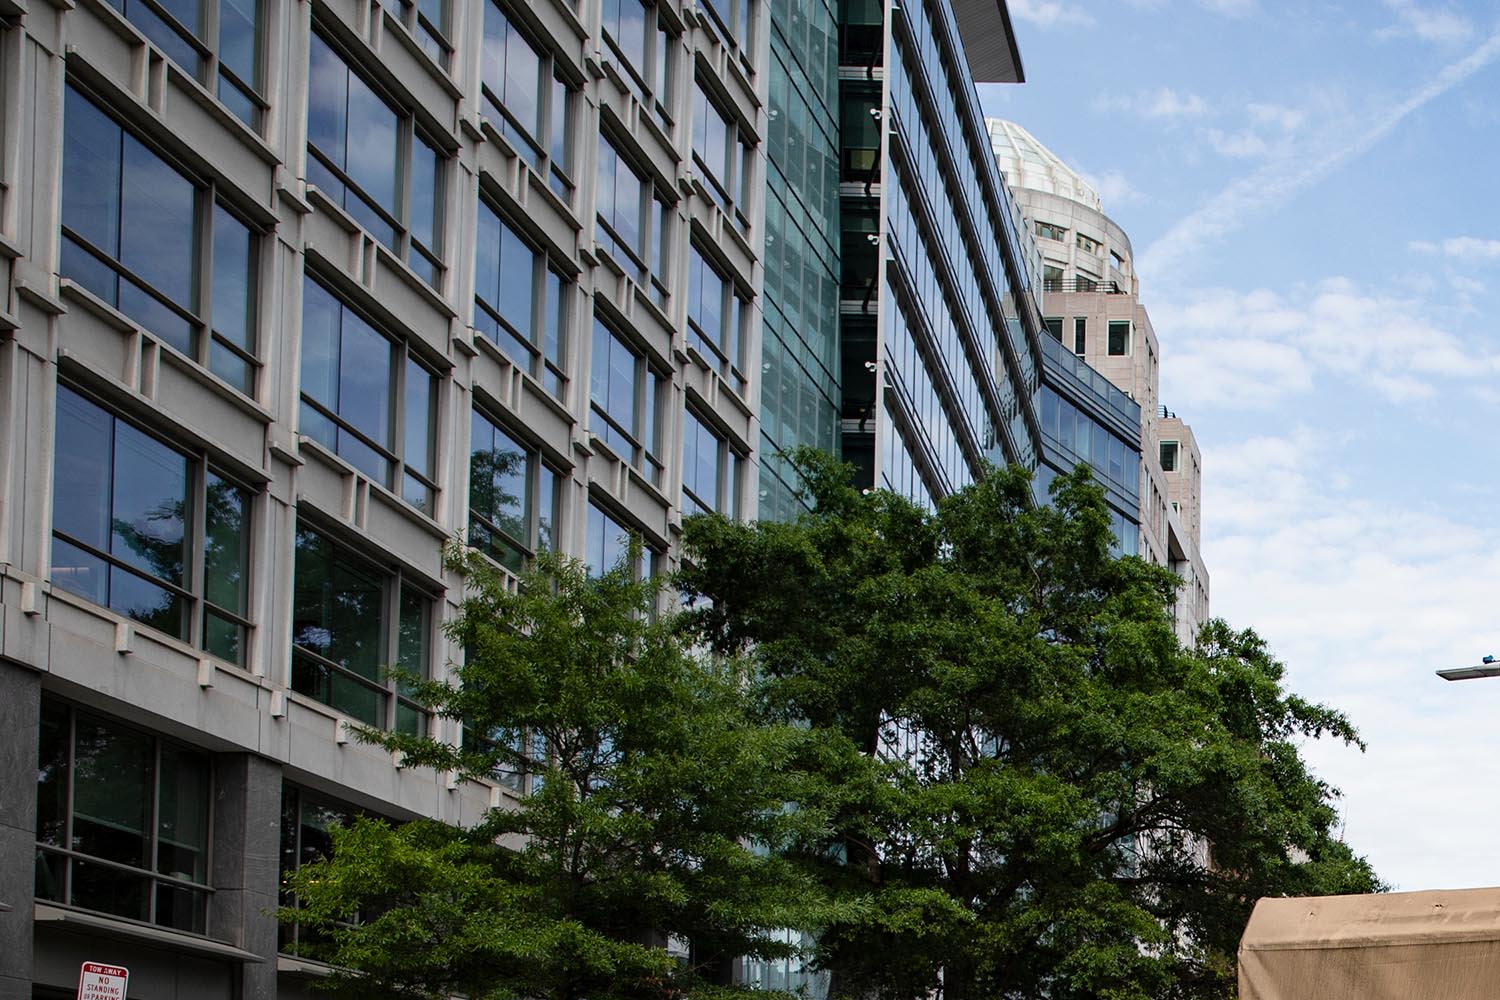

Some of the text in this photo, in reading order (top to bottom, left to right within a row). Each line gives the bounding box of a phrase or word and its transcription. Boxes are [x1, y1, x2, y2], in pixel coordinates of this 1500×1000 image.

[90, 965, 122, 976] TOW AWAY
[98, 976, 110, 985] NO
[87, 984, 120, 995] STANDING
